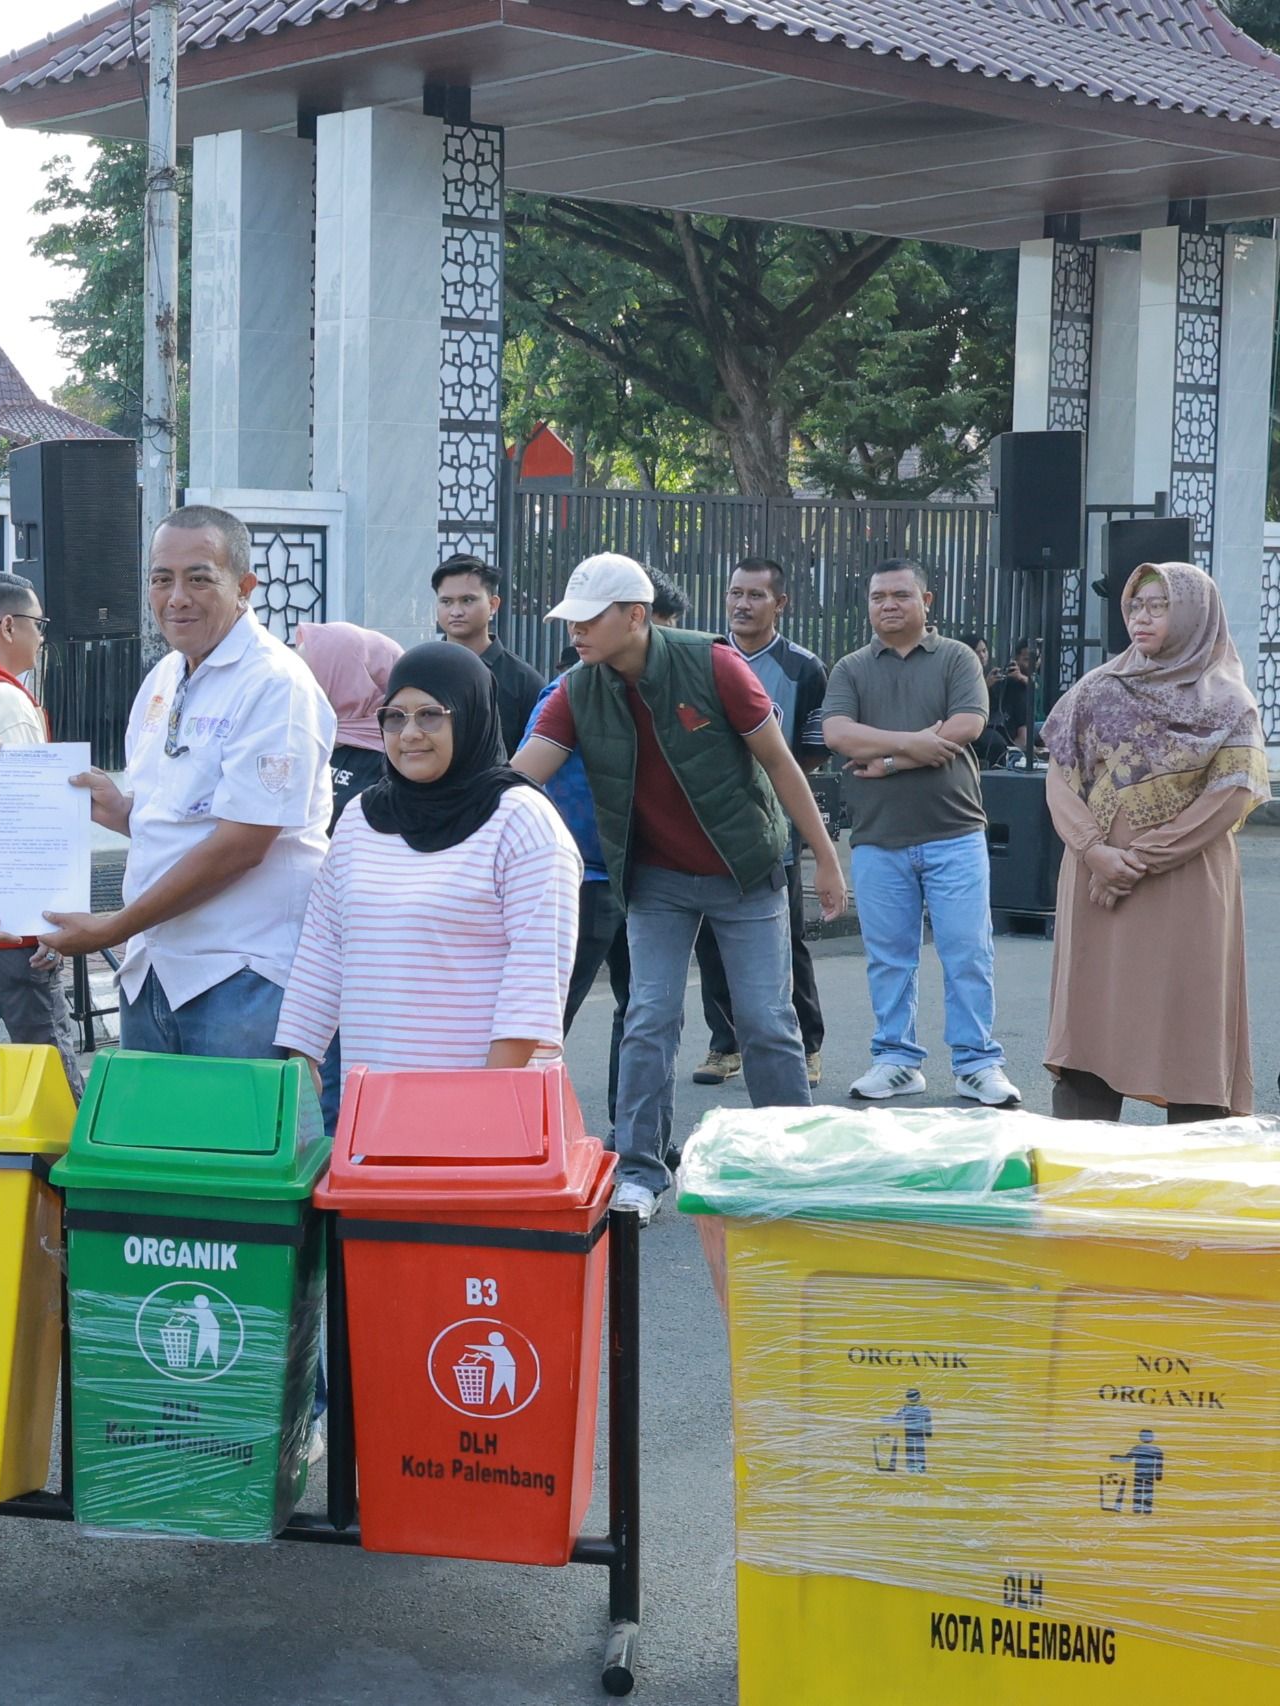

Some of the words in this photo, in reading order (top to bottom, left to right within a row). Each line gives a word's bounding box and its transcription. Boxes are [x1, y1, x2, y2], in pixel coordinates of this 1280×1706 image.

[123, 1236, 238, 1271] ORGANIK
[465, 1277, 498, 1306] B3
[848, 1346, 968, 1369] ORGANIK
[1136, 1355, 1192, 1375] NON
[162, 1400, 200, 1422] DLH
[1098, 1384, 1226, 1410] ORGANIK
[105, 1420, 147, 1445] Kota
[154, 1426, 253, 1467] Palembang
[460, 1431, 498, 1455] DLH
[401, 1455, 445, 1479] Kota
[452, 1459, 555, 1496] Palembang
[1003, 1572, 1044, 1610] DLH
[930, 1612, 984, 1654] KOTA
[992, 1618, 1116, 1665] PALEMBANG
